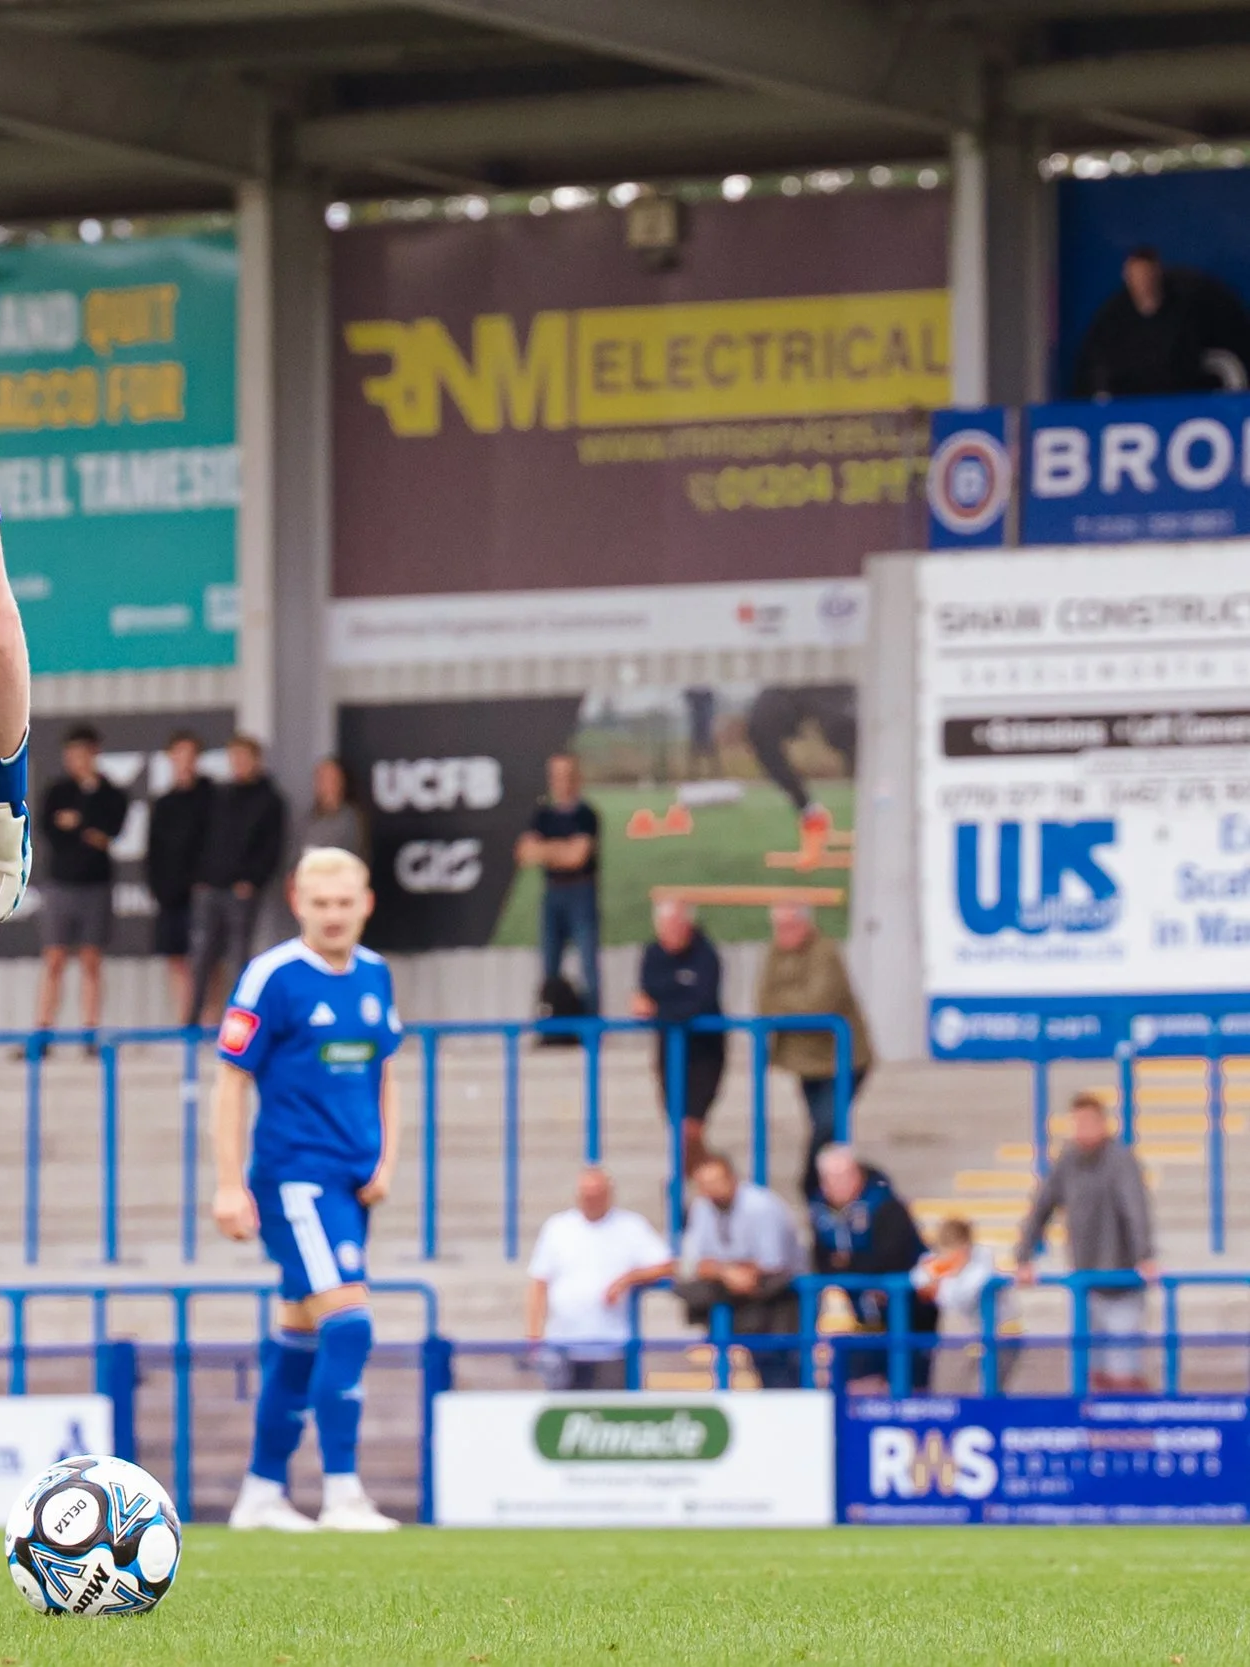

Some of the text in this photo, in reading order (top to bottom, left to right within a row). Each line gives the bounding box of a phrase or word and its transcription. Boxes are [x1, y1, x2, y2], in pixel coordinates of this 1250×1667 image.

[82, 284, 180, 356] QUIT
[588, 324, 949, 396] ELECTRICAL
[105, 361, 186, 425] FOR
[1031, 417, 1250, 498] BRO
[372, 755, 504, 812] UCFB
[557, 1408, 707, 1458] Pinnacle
[54, 1498, 87, 1535] DELTA
